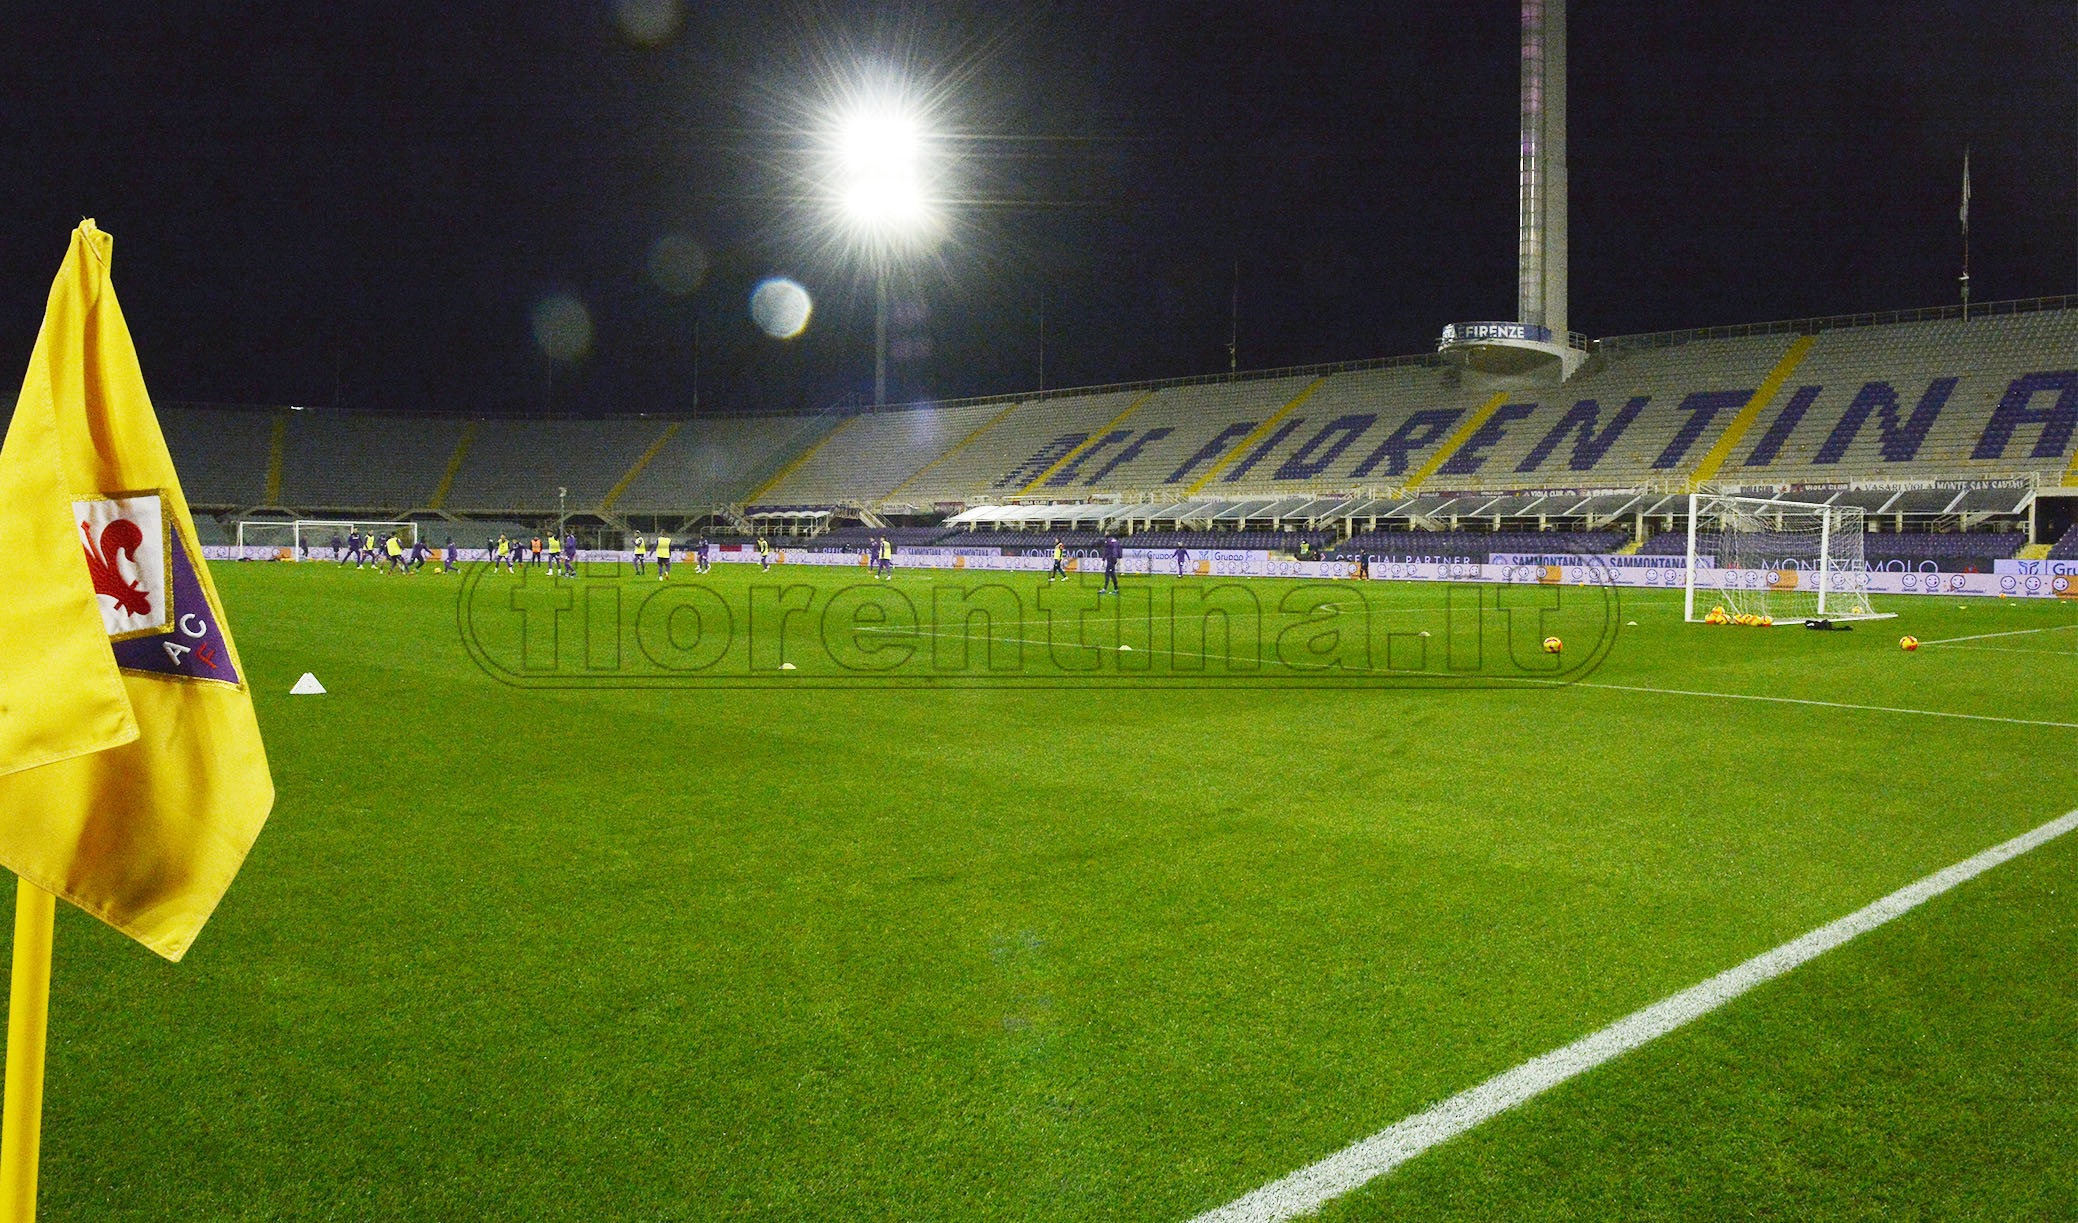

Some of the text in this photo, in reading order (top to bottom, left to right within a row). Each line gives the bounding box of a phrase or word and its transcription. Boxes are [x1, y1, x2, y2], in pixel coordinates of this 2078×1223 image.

[1466, 325, 1524, 339] FIRENZE
[1164, 369, 2078, 484] FIORENTINA
[1021, 548, 1100, 559] MONTEEMOLO
[1336, 554, 1471, 565] OFFCIAL PARTNER
[1512, 555, 1583, 567] SAMMONTANA
[1609, 556, 1687, 568] SAMMONTANA
